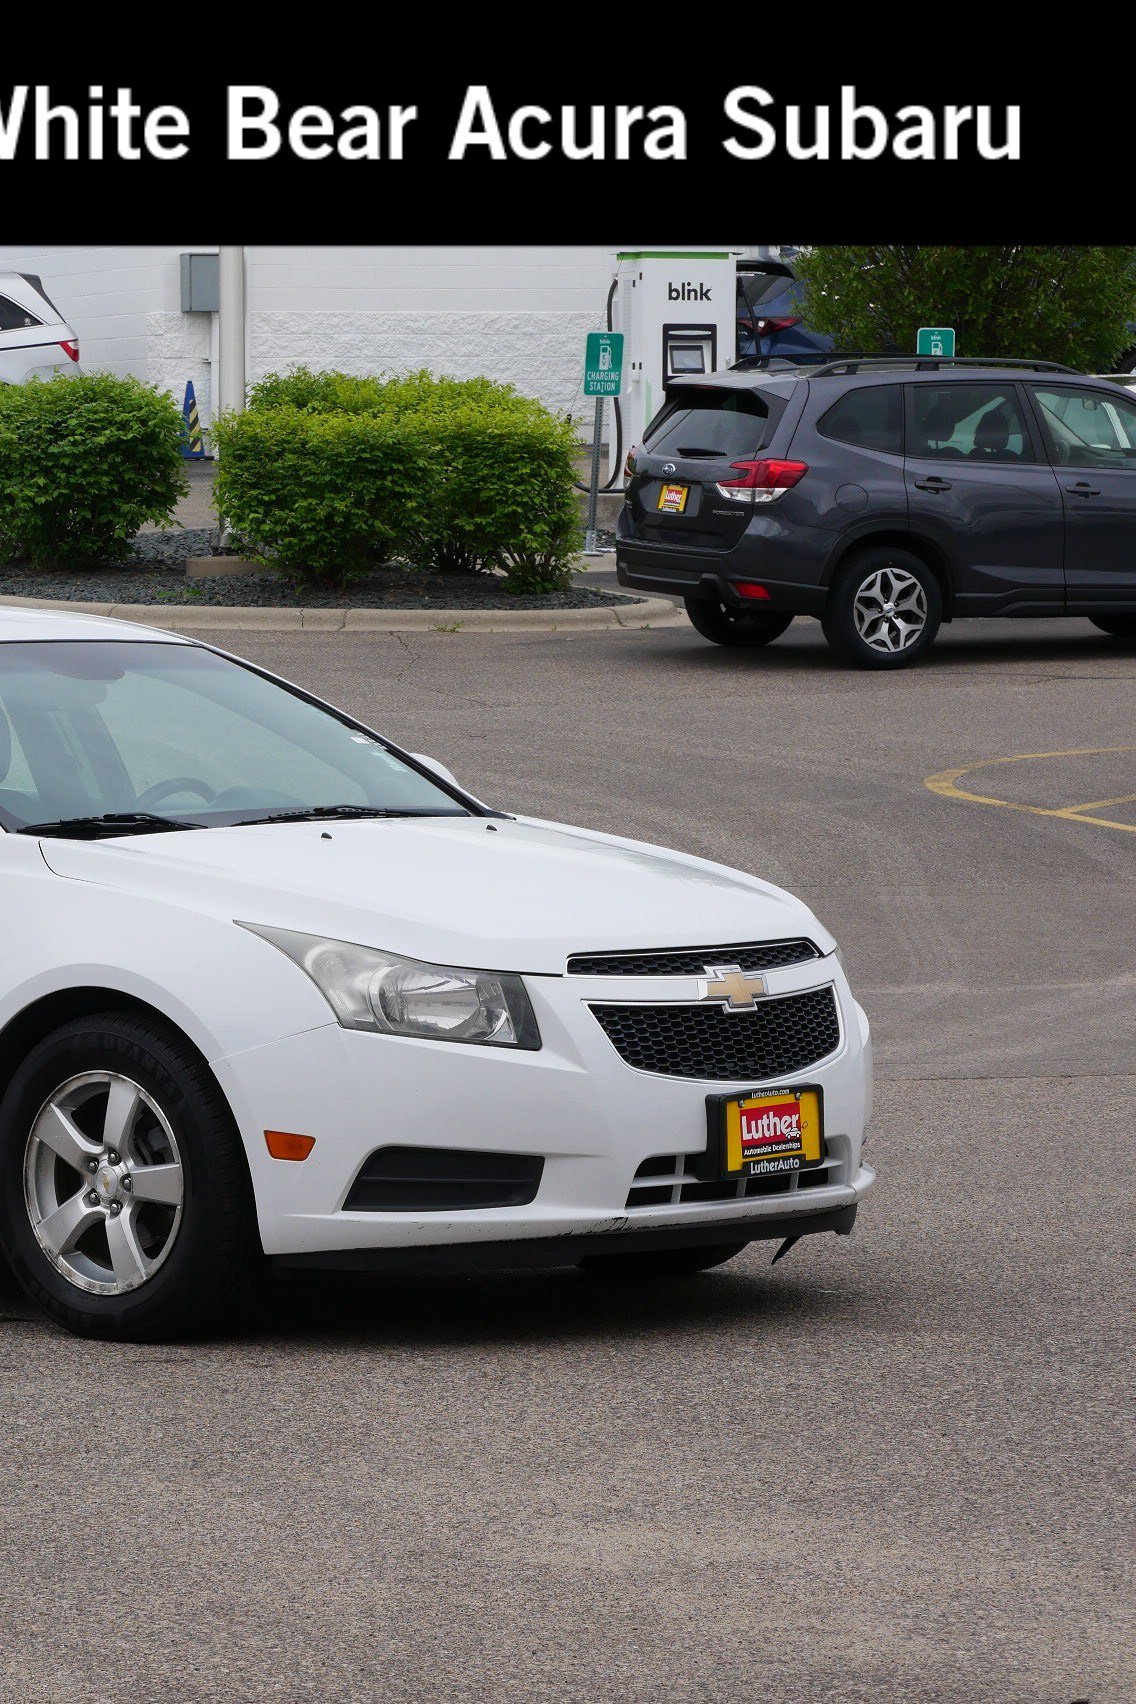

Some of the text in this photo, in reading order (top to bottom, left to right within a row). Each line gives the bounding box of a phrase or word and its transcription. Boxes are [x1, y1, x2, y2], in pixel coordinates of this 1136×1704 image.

[668, 281, 712, 301] blink
[587, 371, 619, 381] CHARGING
[589, 382, 616, 391] STATION
[664, 490, 682, 502] Luther
[751, 1089, 790, 1099] LutherAuto.com
[741, 1111, 800, 1141] Luther
[744, 1142, 801, 1156] Automobile Dealerships
[750, 1158, 800, 1175] LutherAuto
